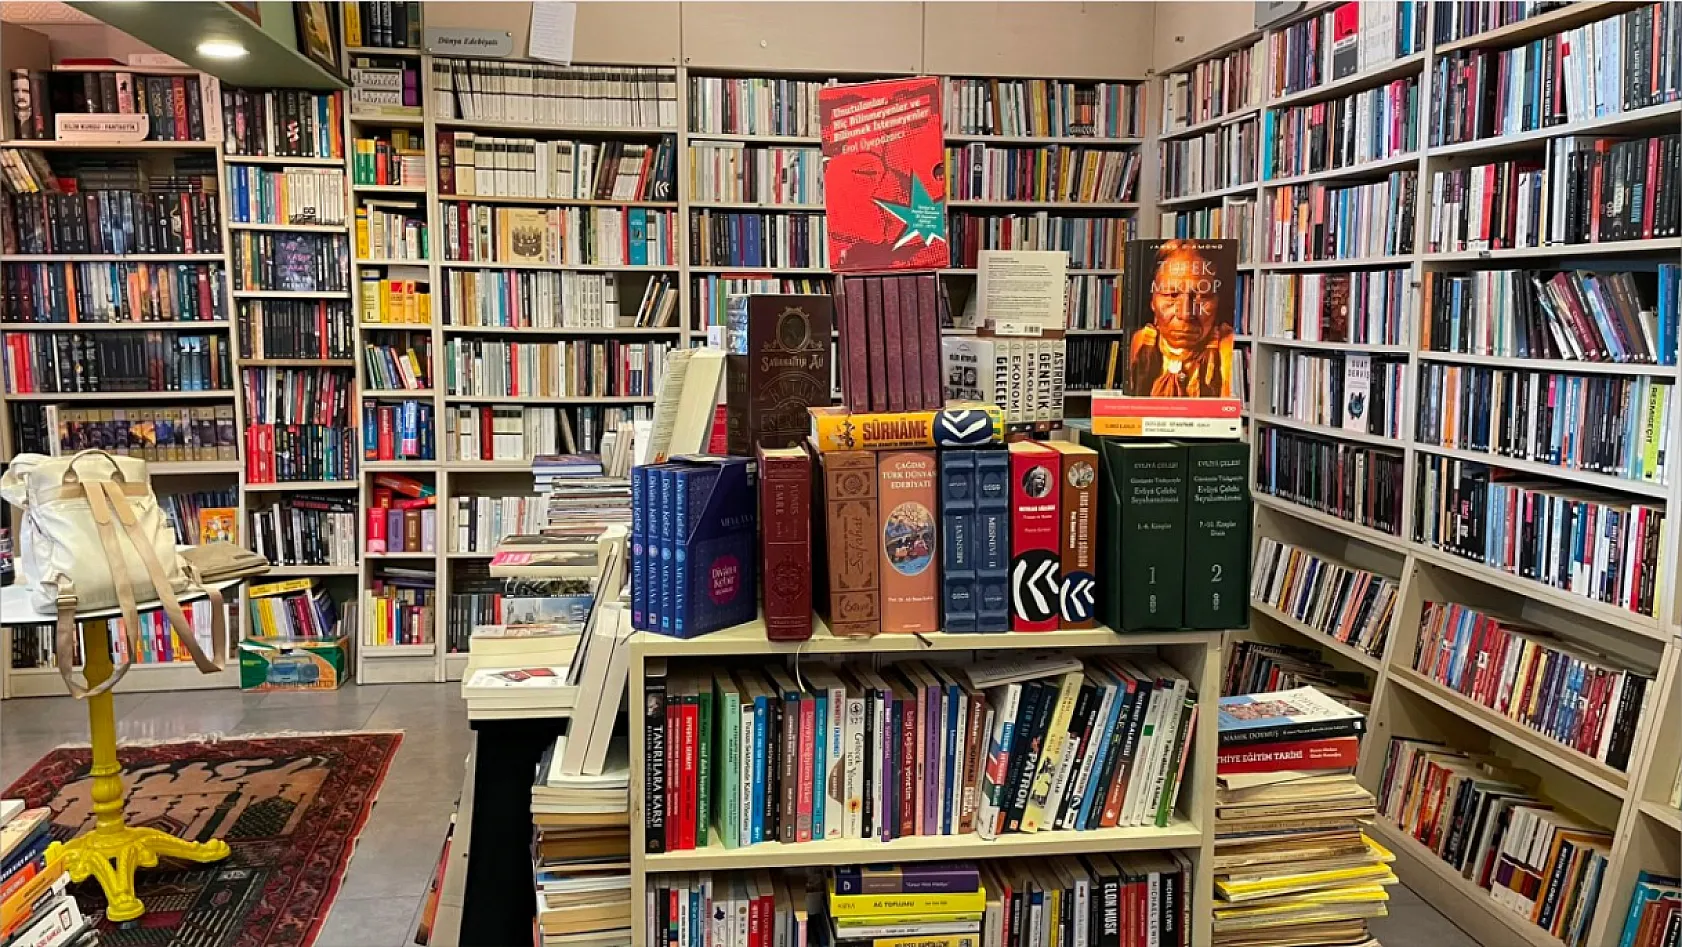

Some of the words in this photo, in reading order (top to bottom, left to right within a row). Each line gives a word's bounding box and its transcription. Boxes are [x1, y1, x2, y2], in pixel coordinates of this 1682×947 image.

[437, 36, 462, 46] Dünya
[464, 37, 498, 47] Edebiyatı
[833, 97, 888, 118] Unutulanlar,
[833, 120, 848, 131] Hiç
[848, 101, 908, 126] Bilinmeyenler
[910, 99, 920, 109] ve
[833, 124, 871, 142] Bilinmek
[842, 142, 858, 154] Erol
[775, 484, 784, 515] EMRE
[1149, 566, 1156, 584] 1
[1211, 564, 1222, 582] 2
[905, 711, 914, 730] bilgi
[652, 725, 664, 792] TANRILARA
[854, 732, 863, 765] Gelecek
[1274, 750, 1303, 760] TARİHİ
[904, 766, 912, 800] yönetim
[1014, 753, 1038, 809] PATRON
[652, 794, 663, 828] KARŞI
[1104, 882, 1117, 907] ELON
[1104, 909, 1117, 936] MUSK
